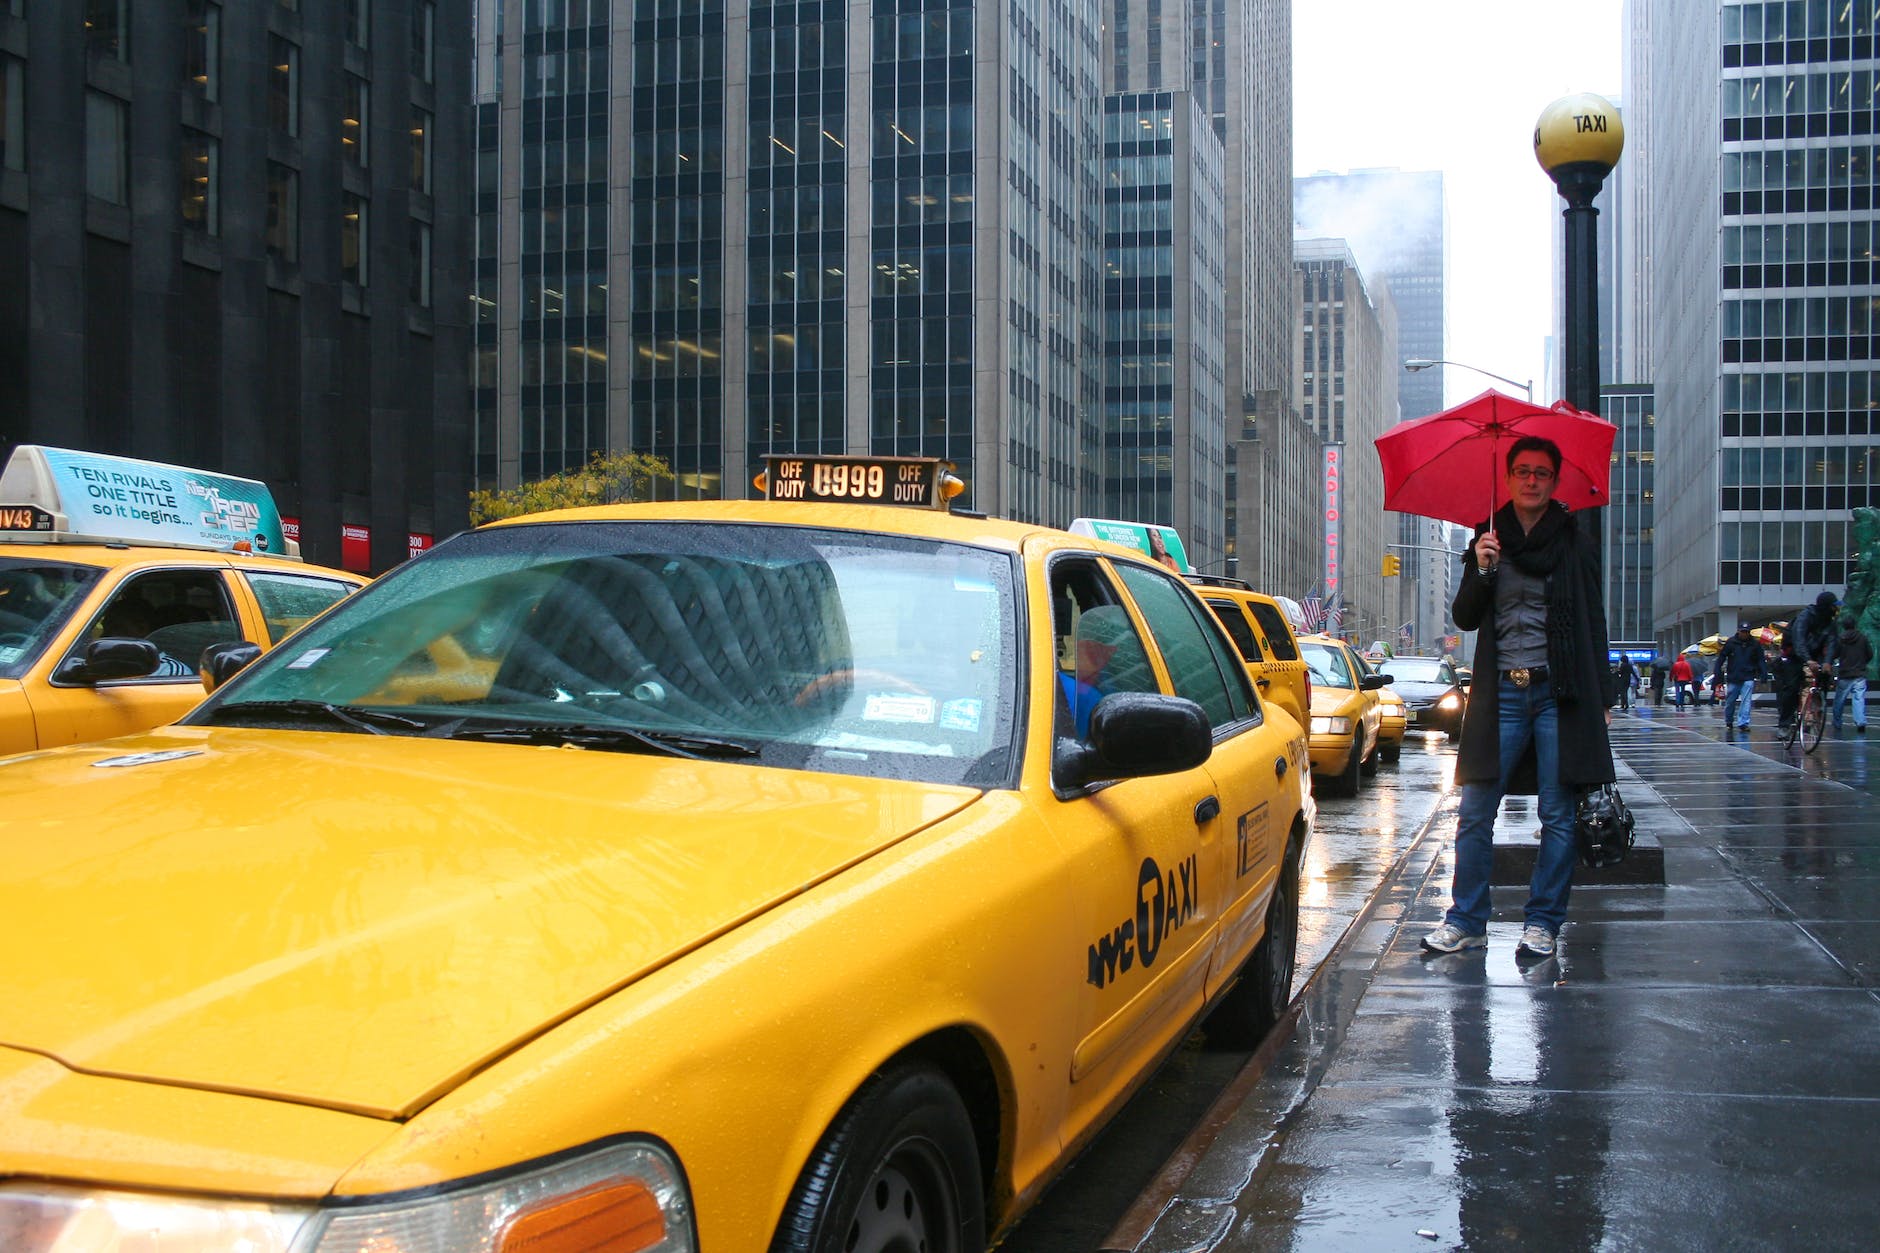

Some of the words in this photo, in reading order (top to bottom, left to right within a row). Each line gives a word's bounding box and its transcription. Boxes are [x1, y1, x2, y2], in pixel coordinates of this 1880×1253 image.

[1573, 115, 1607, 133] TAXI
[68, 466, 109, 483] TEN
[111, 472, 173, 493] RIVALS
[780, 461, 803, 479] OFF
[899, 464, 922, 482] OFF
[87, 484, 127, 502] ONE
[129, 490, 178, 509] TITLE
[776, 479, 806, 498] DUTY
[894, 483, 925, 502] DUTY
[1325, 451, 1339, 522] RADIO
[0, 509, 32, 529] V43
[92, 503, 112, 516] so
[115, 504, 128, 518] it
[130, 506, 193, 525] begins...
[209, 497, 261, 519] IRON
[201, 511, 259, 534] CHEF
[1325, 532, 1339, 591] CITY
[1087, 918, 1134, 989] NYC
[1137, 853, 1198, 968] TAXI
